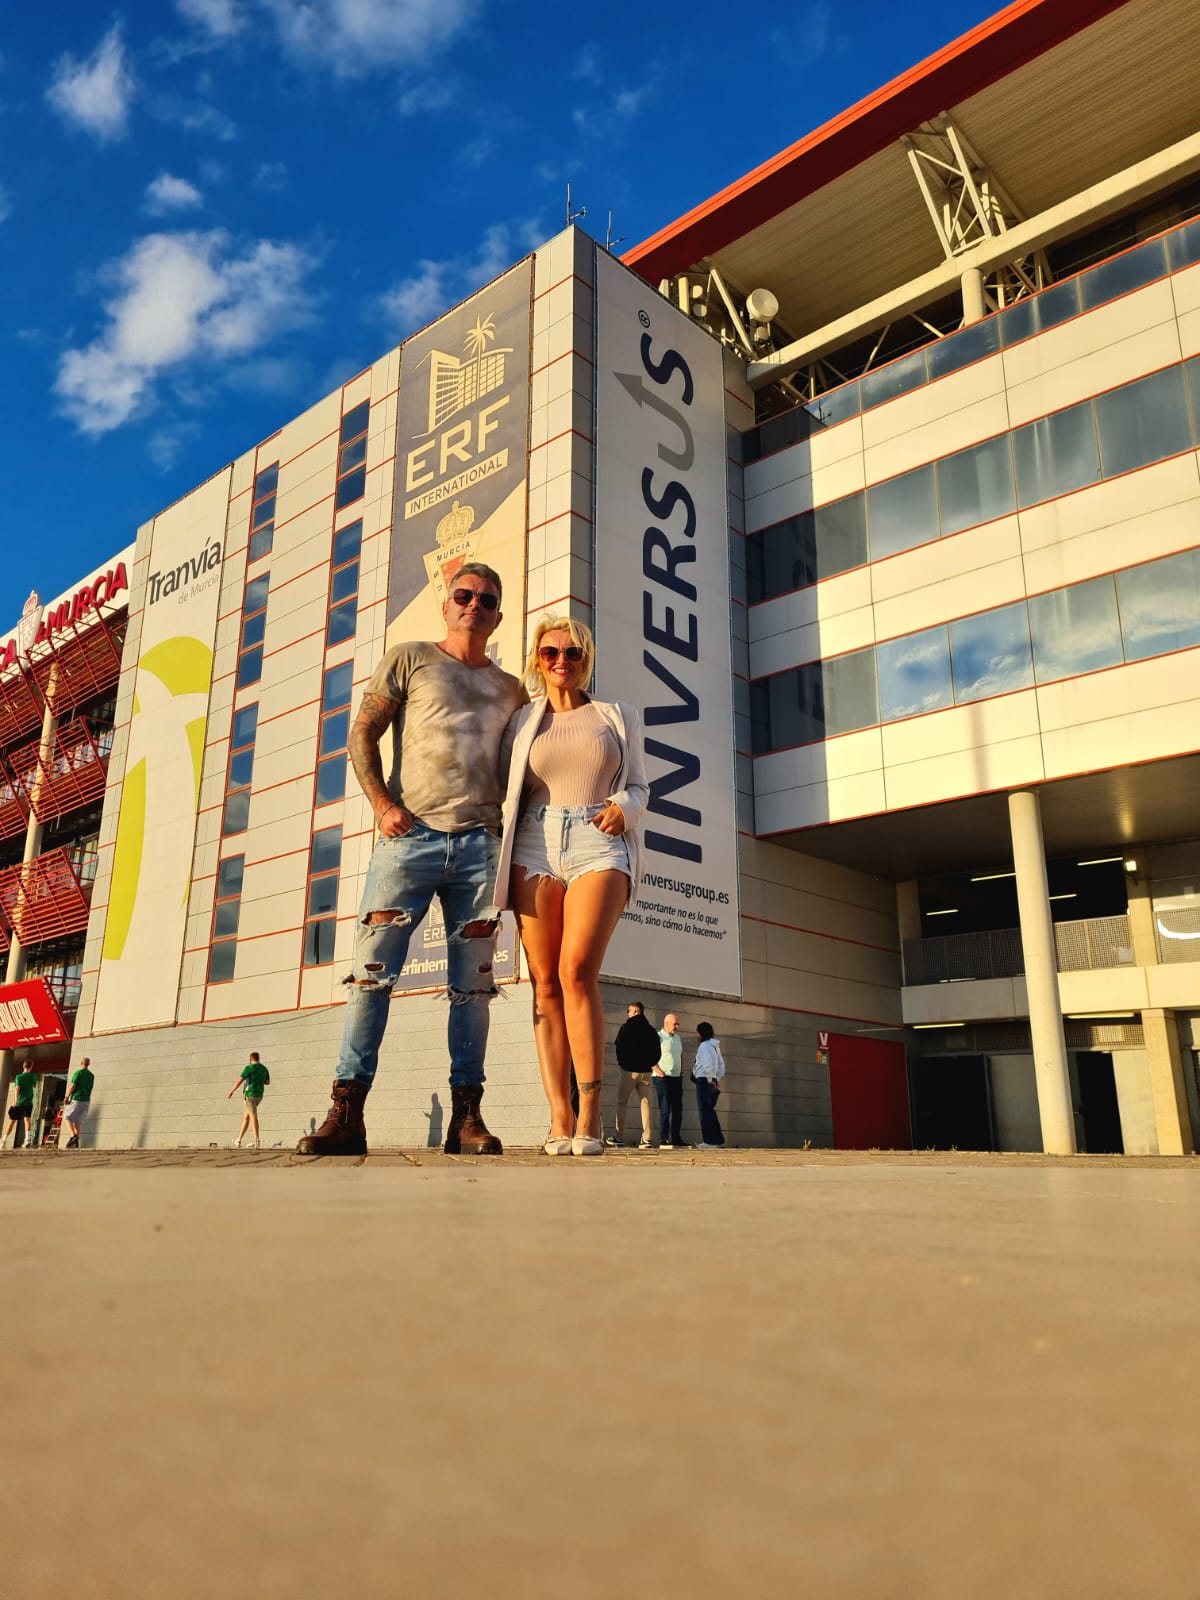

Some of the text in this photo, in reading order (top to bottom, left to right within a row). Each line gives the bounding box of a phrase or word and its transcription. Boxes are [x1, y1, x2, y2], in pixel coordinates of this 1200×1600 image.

[406, 394, 511, 493] ERF
[410, 455, 502, 513] INTERNATIONAL
[436, 540, 471, 562] MURCIA
[149, 536, 222, 606] Tranvía
[45, 562, 128, 637] MURCIA
[178, 574, 219, 605] de Murcia
[641, 873, 730, 905] nversusgroup.es
[636, 899, 719, 926] mportante no es lo que
[645, 914, 661, 926] sino
[662, 918, 683, 931] cómo
[684, 924, 692, 933] lo
[819, 1031, 829, 1047] V
